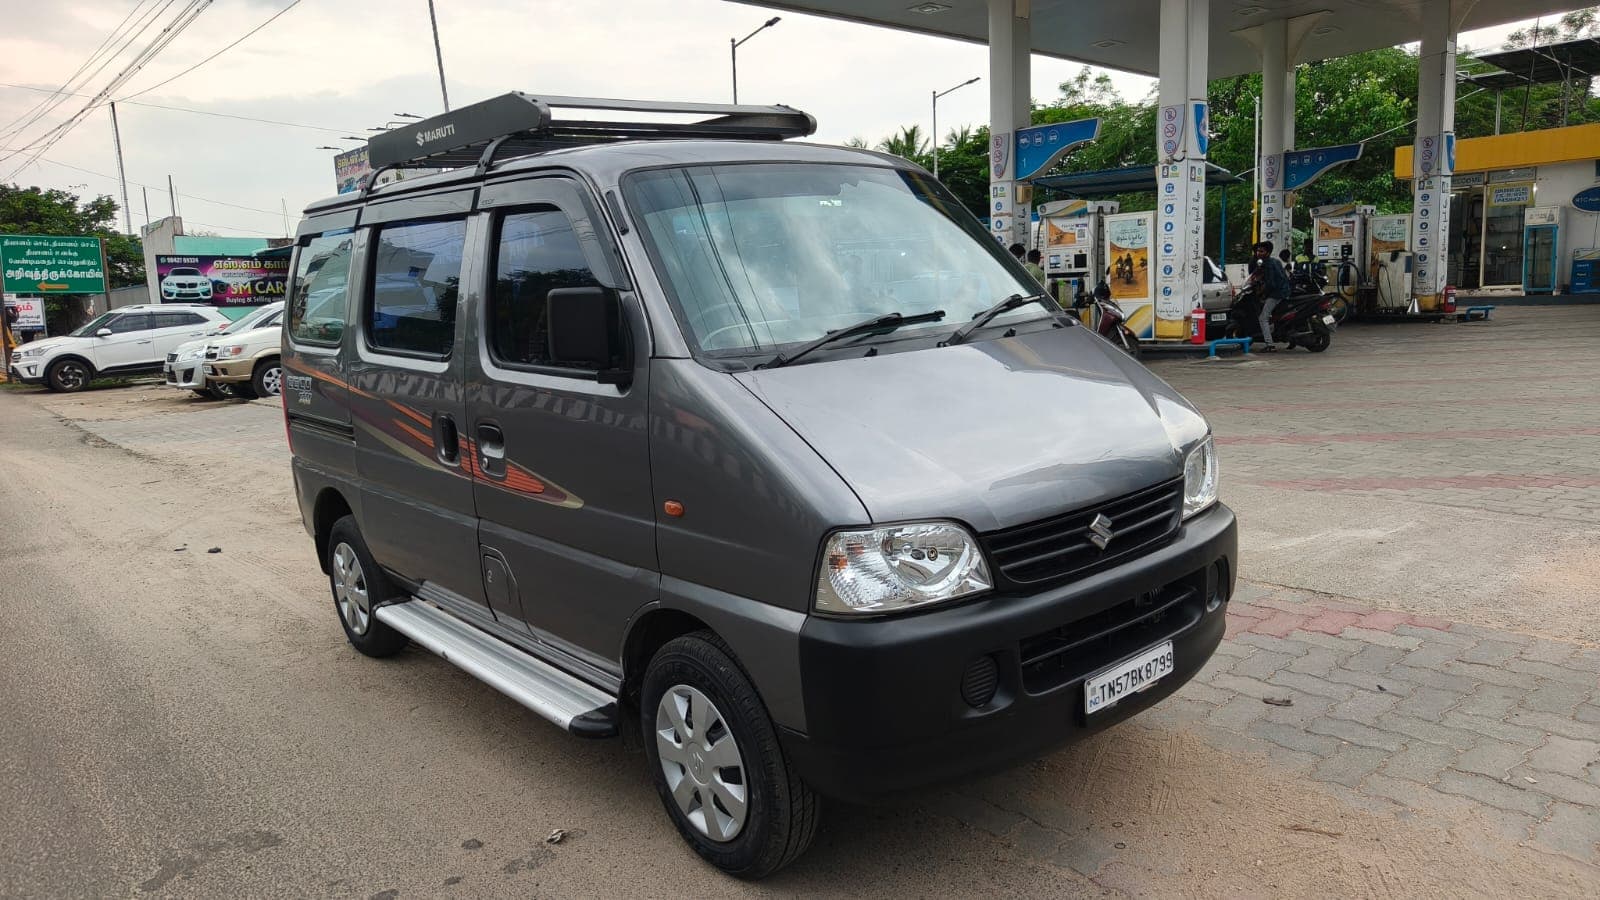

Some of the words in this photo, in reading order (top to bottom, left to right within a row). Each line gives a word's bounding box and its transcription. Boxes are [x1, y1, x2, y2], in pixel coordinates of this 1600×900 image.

[424, 124, 455, 142] MARUTI
[231, 281, 252, 295] SM
[1100, 652, 1172, 702] TN57BK8799
